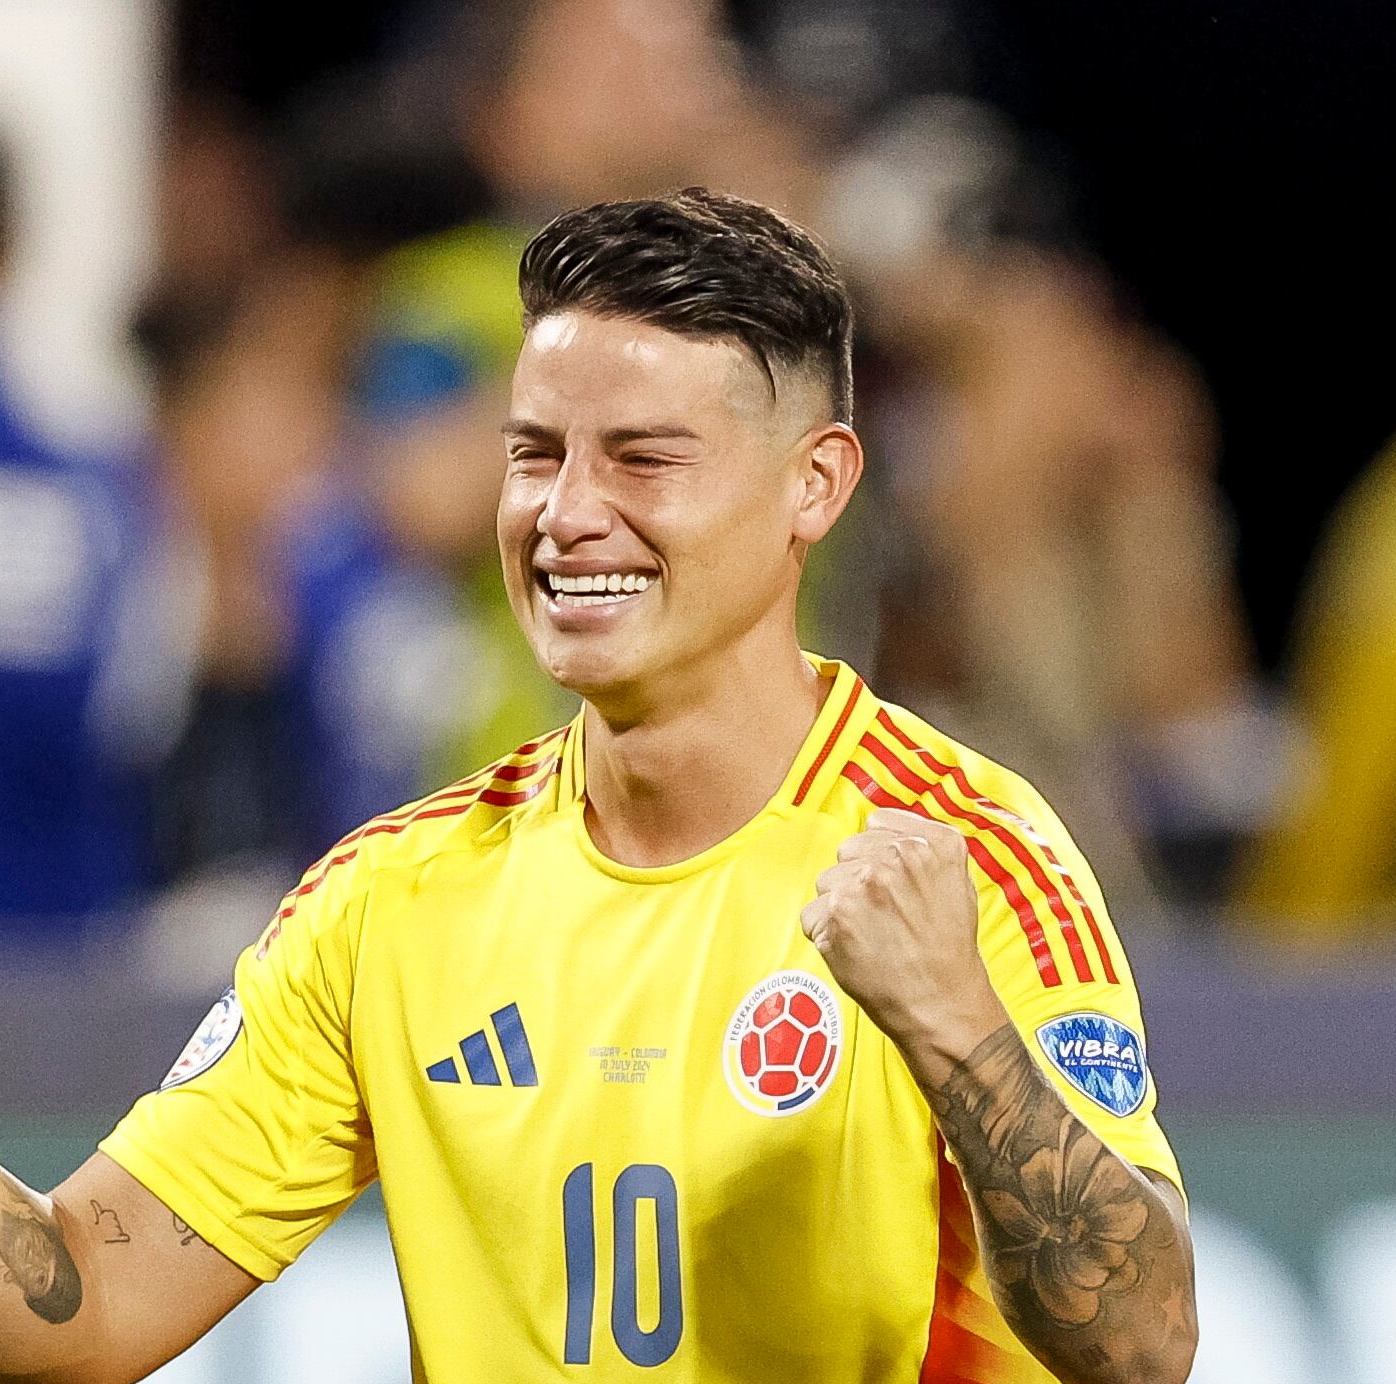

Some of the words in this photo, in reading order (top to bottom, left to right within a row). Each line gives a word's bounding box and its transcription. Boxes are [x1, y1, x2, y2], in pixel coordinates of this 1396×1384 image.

[767, 975, 819, 995] COLOMBIANA
[818, 991, 830, 1004] DE
[1059, 1039, 1137, 1065] VIBRA
[603, 1071, 647, 1084] CHARLOTTE
[1064, 1058, 1078, 1067] EL
[1080, 1058, 1140, 1074] CONTINENTE
[562, 1161, 684, 1368] 10
